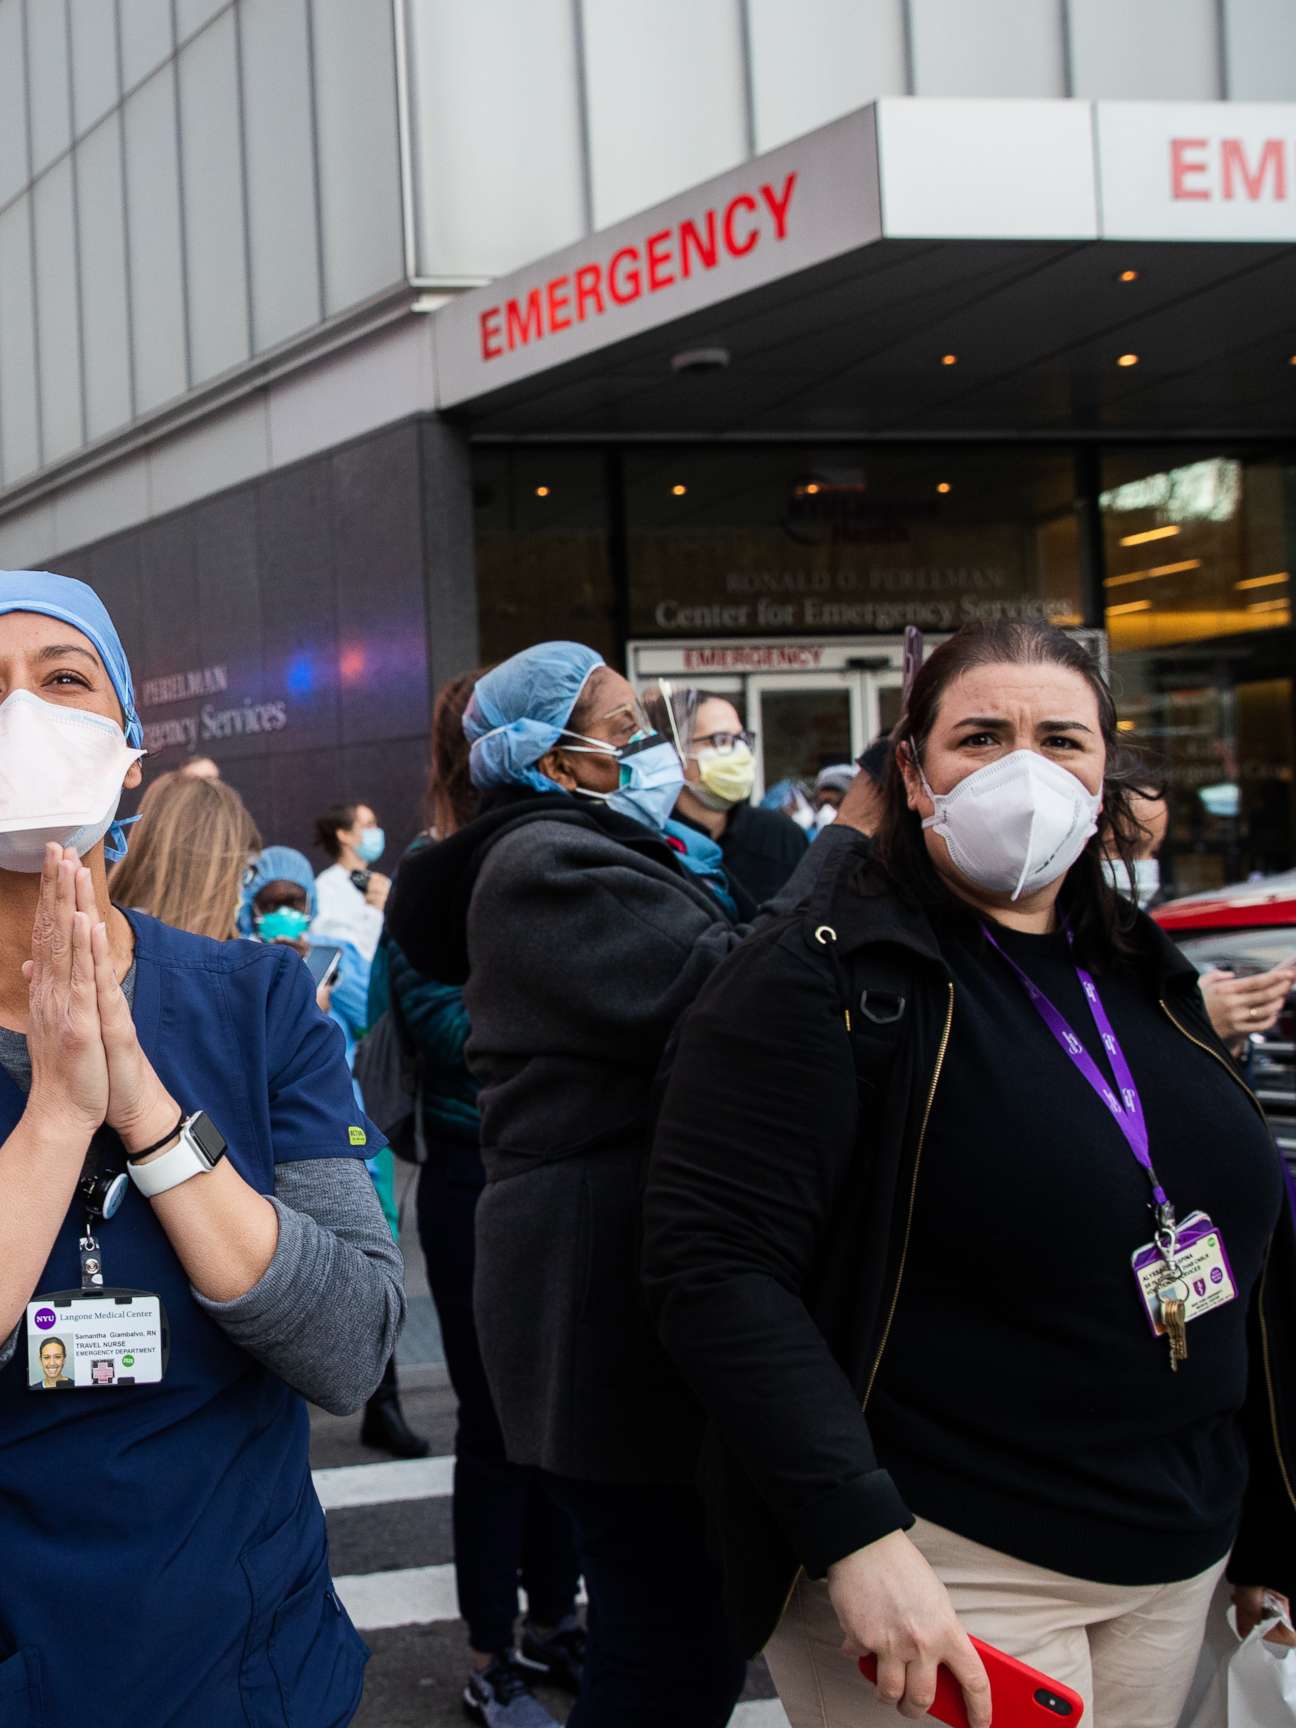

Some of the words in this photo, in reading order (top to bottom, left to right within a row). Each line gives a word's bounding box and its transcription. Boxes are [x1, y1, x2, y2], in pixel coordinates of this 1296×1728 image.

[478, 170, 799, 363] EMERGENCY
[655, 600, 749, 628] Center
[757, 597, 794, 626] for
[803, 597, 953, 631] Emergency
[683, 647, 825, 670] EMERGENCY
[200, 697, 289, 740] Services
[36, 1314, 55, 1323] NYU
[60, 1312, 93, 1322] Langone
[94, 1311, 125, 1319] Medical
[126, 1310, 153, 1318] Center
[75, 1332, 107, 1340] Samantha
[103, 1340, 126, 1348] NURSE
[76, 1349, 115, 1357] EMERGENCY
[115, 1347, 156, 1355] DEPARTMENT
